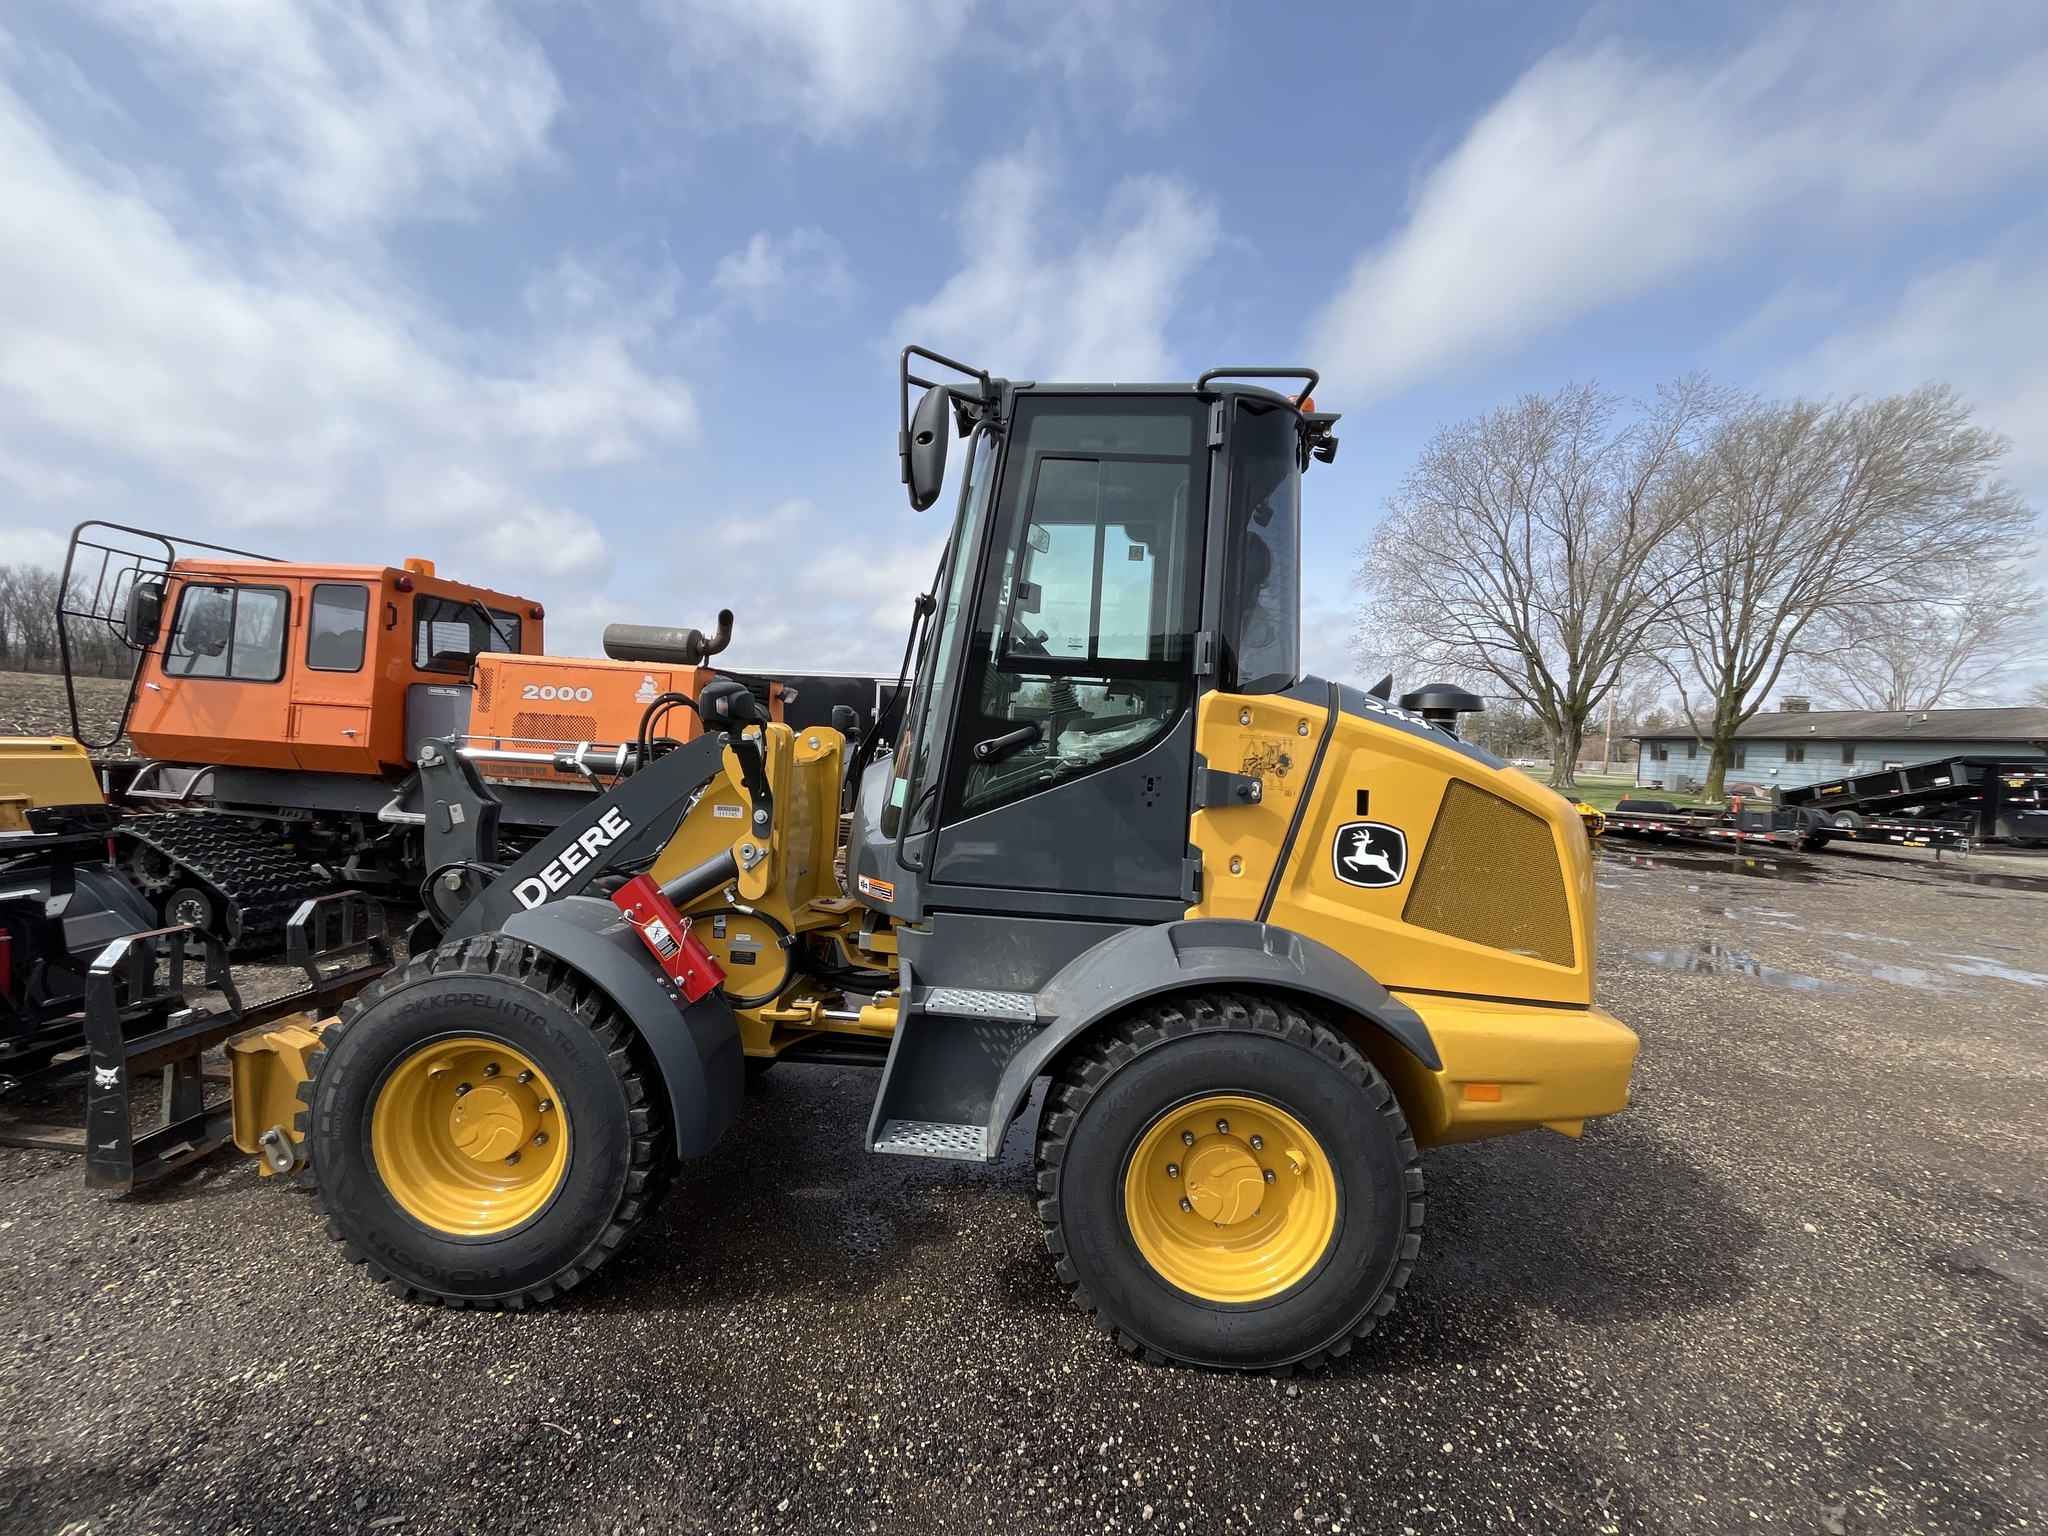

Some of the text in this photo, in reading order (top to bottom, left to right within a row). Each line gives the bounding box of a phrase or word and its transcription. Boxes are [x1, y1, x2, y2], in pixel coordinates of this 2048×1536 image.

[522, 684, 593, 702] 2000
[1364, 698, 1434, 731] 244
[512, 806, 631, 910] DEERE
